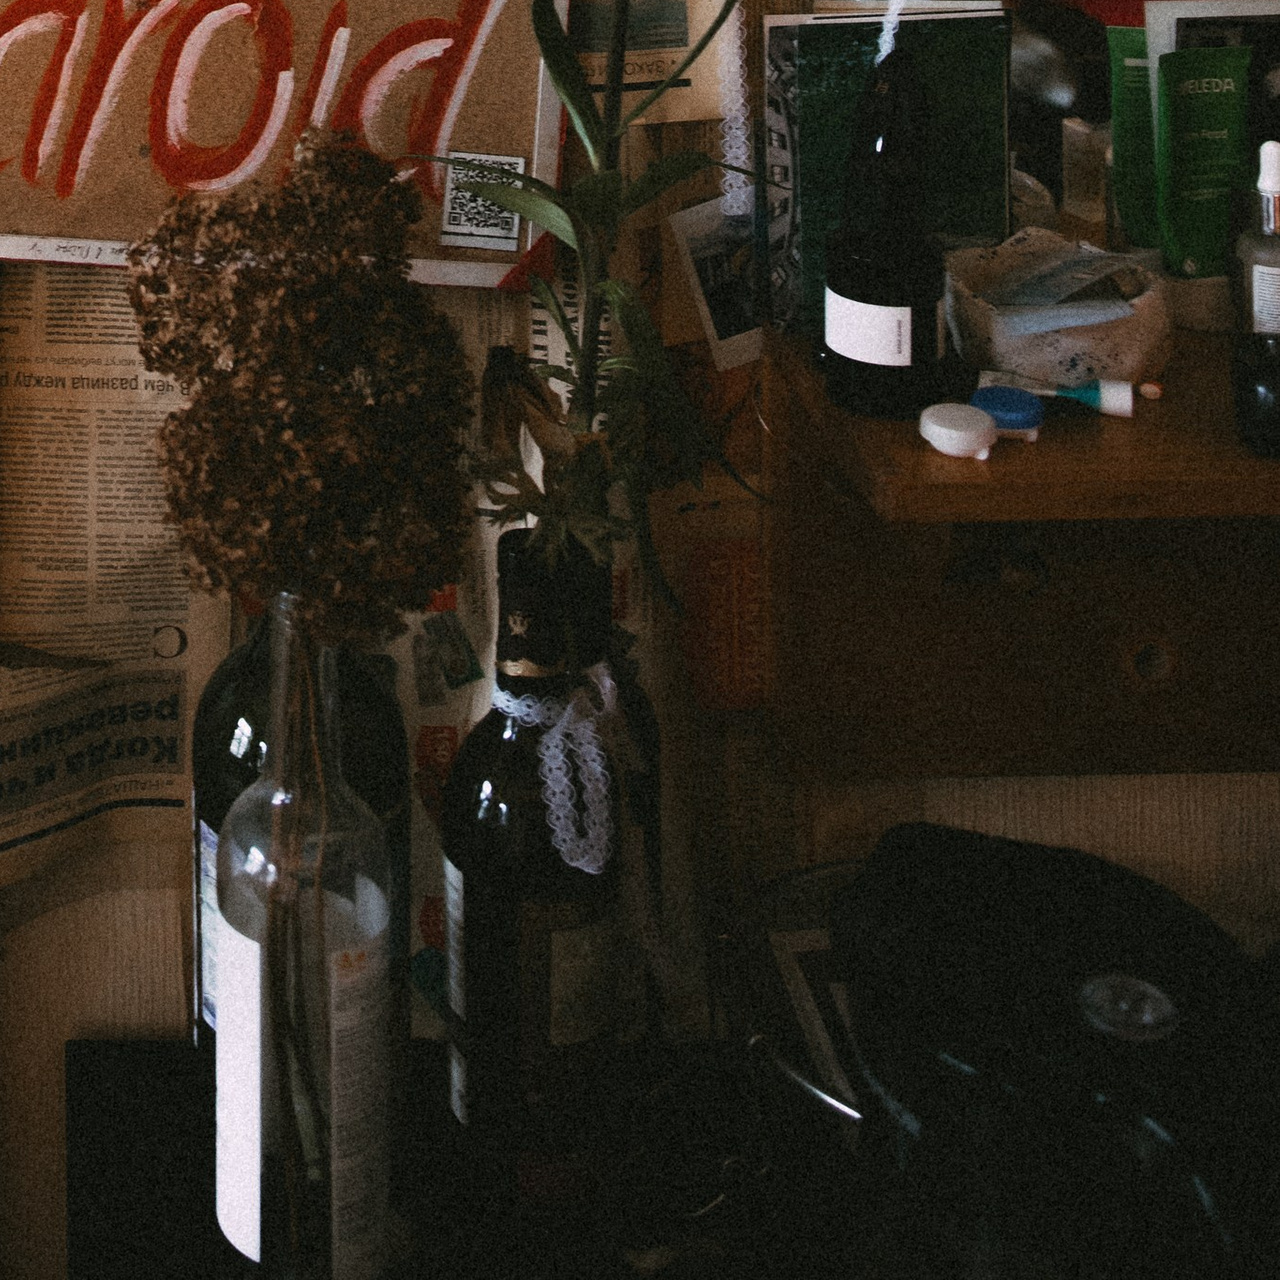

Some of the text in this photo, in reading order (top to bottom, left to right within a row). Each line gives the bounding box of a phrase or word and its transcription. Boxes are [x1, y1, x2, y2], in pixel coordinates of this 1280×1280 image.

[13, 372, 66, 389] между
[71, 375, 138, 390] разница
[153, 626, 188, 658] С
[64, 735, 178, 775] Когда
